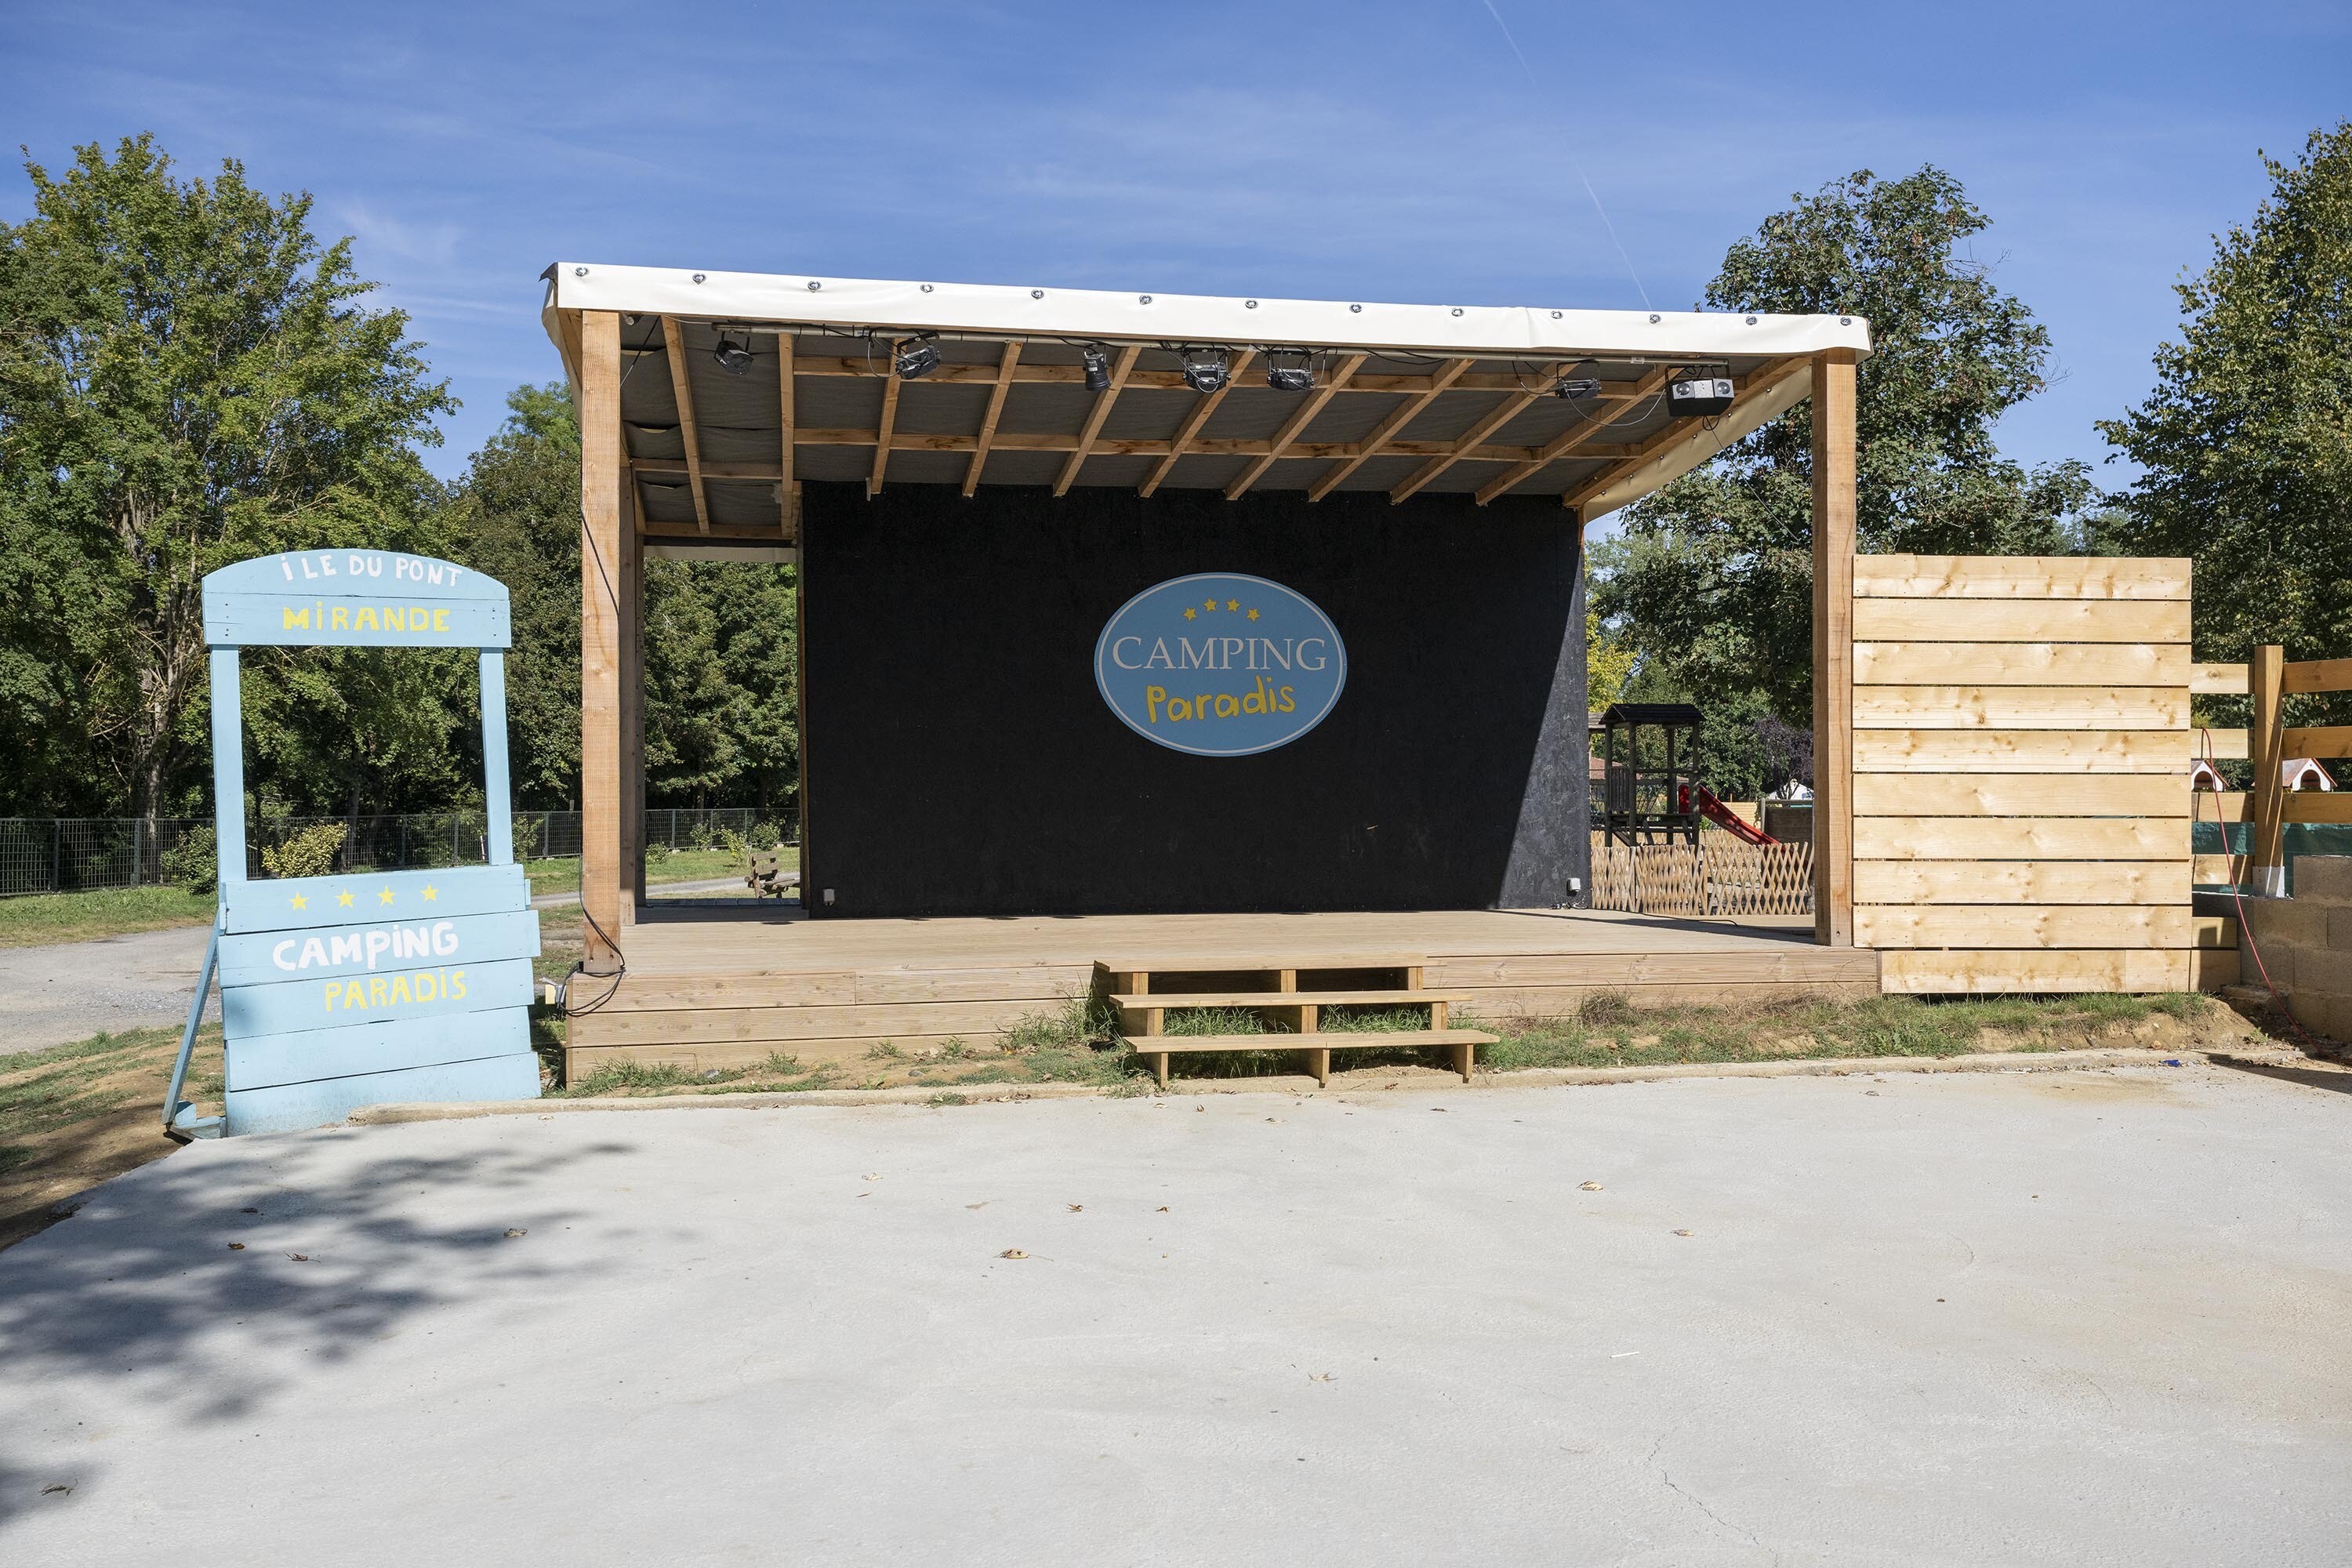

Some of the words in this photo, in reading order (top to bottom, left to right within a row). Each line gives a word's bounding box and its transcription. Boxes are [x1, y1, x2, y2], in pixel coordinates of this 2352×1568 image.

[349, 556, 383, 578] DU
[395, 557, 462, 586] PONT
[1112, 637, 1327, 670] CAMPING
[1146, 675, 1295, 724] Paradis
